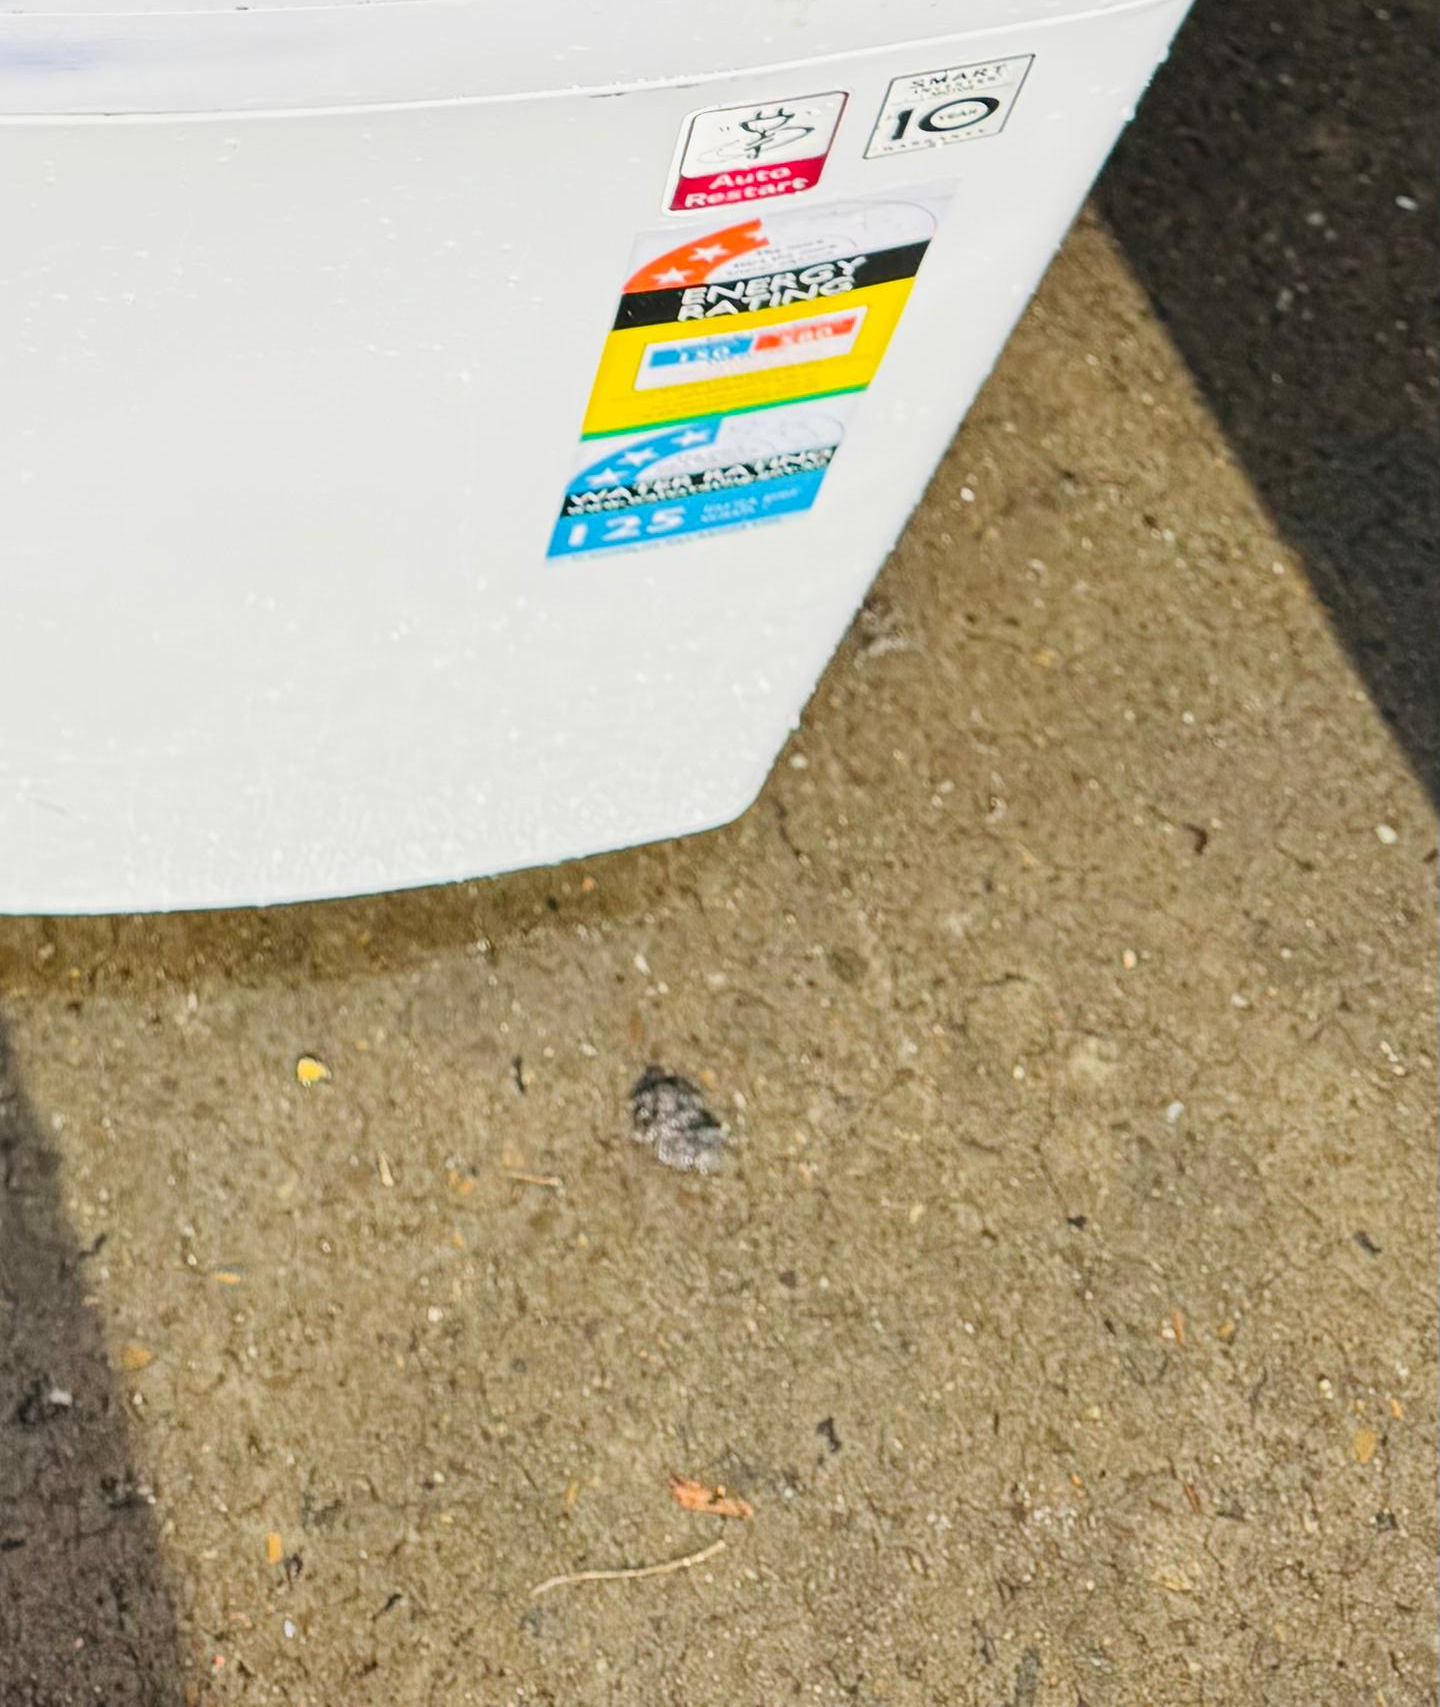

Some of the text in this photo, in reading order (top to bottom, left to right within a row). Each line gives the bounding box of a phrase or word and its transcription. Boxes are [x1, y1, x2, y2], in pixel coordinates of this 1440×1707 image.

[911, 64, 1007, 88] SMART
[891, 97, 1000, 141] 10
[684, 177, 809, 208] Restart
[709, 166, 791, 190] Auto
[677, 276, 856, 322] RATING
[681, 255, 867, 306] ENERGY
